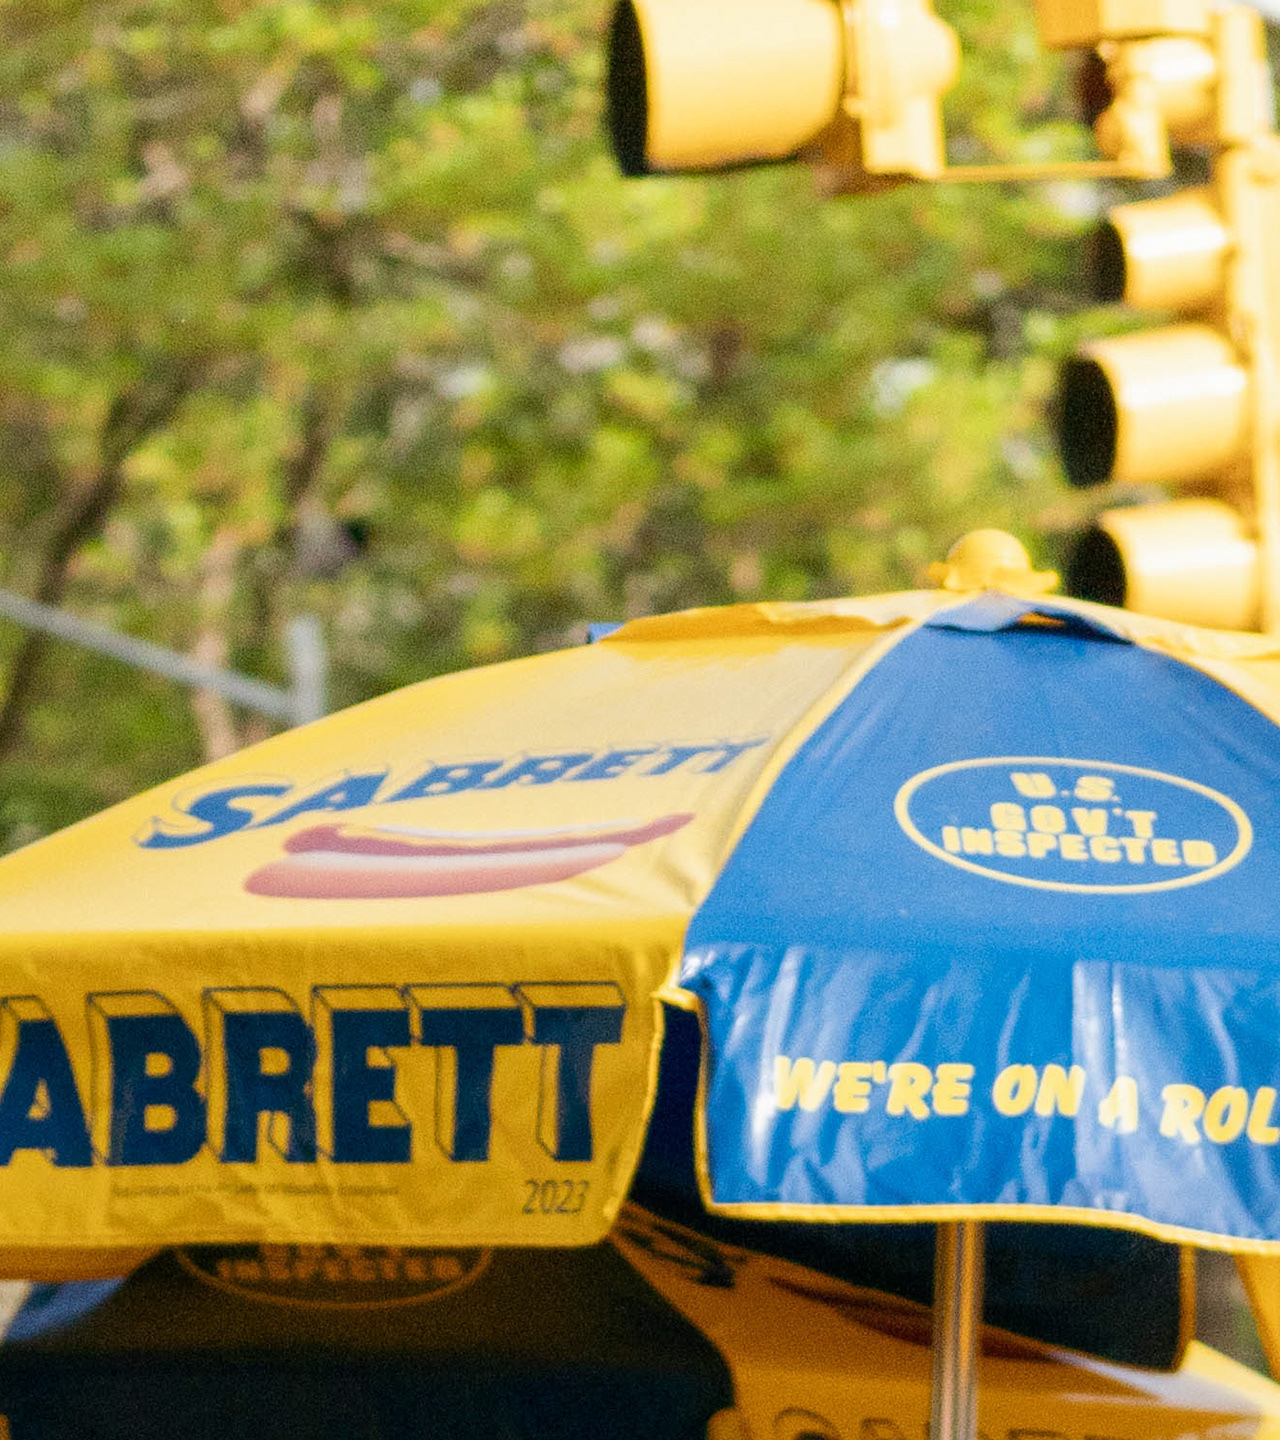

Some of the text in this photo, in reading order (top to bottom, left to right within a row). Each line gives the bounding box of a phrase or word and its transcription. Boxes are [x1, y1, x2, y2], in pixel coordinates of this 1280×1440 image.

[133, 738, 769, 850] SABRETT
[1011, 772, 1121, 802] U.S.
[990, 802, 1157, 838] GOV'T
[942, 825, 1217, 866] INSPECTED
[773, 1055, 975, 1119] WE'RE
[992, 1064, 1085, 1117] ON
[1098, 1076, 1139, 1133] A
[521, 1179, 590, 1215] 2023
